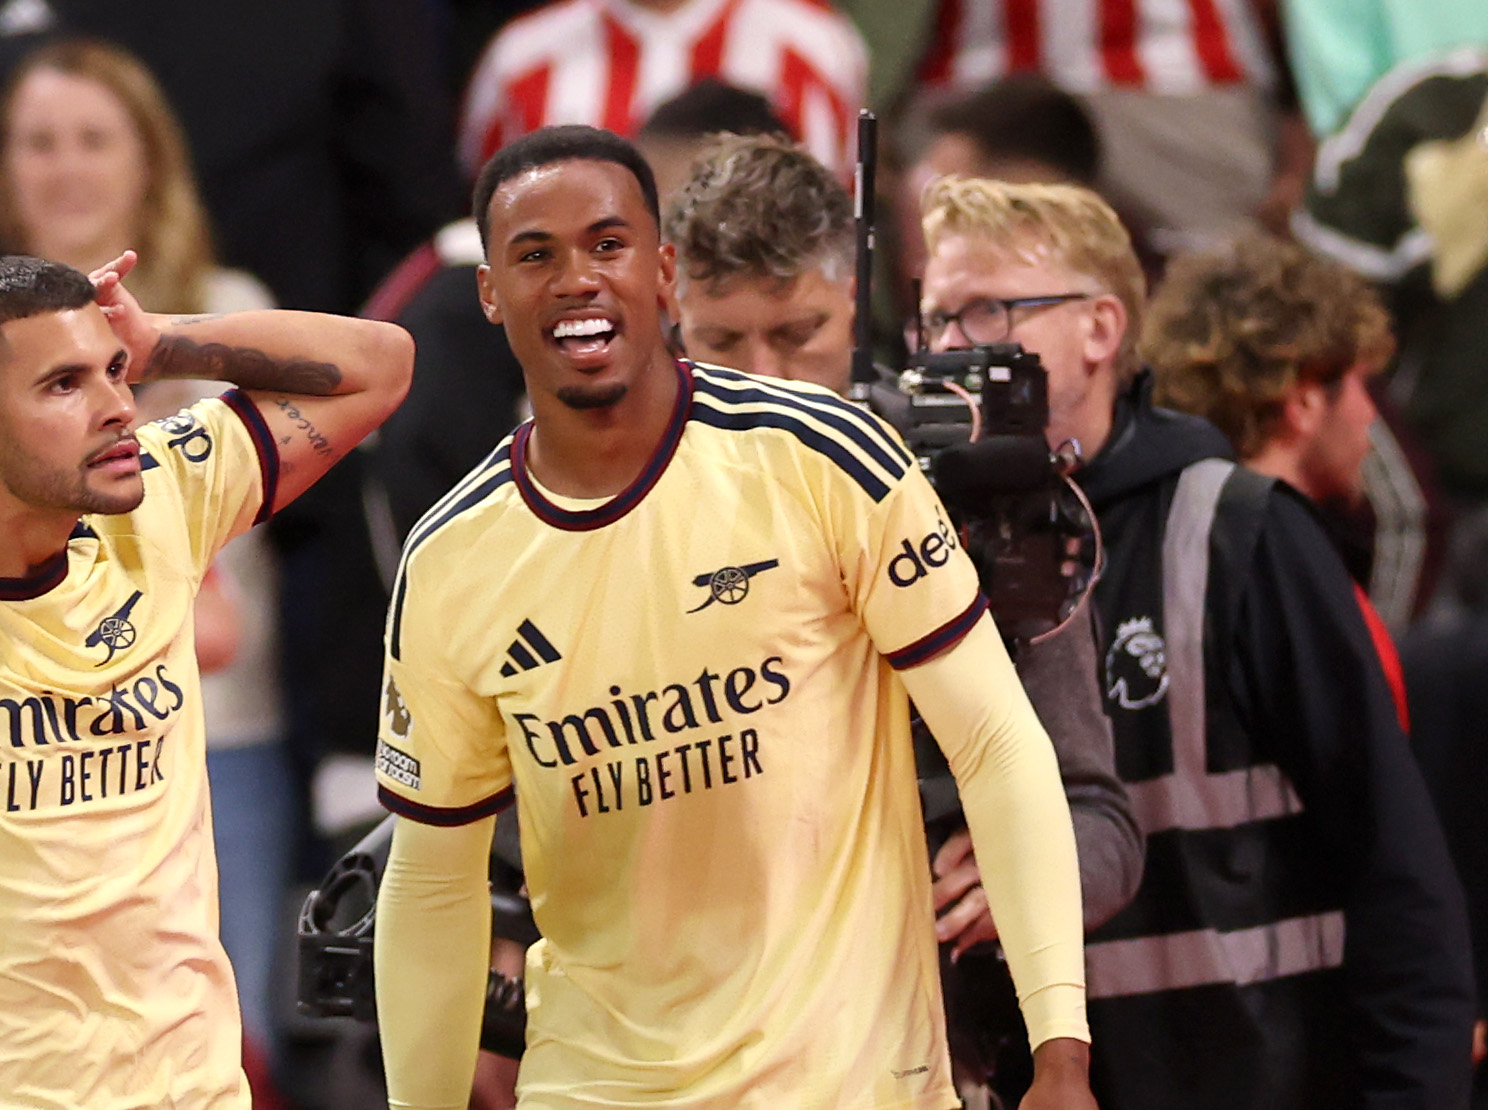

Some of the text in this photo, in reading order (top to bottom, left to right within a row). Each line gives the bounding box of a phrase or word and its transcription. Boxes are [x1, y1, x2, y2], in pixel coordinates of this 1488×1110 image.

[511, 655, 792, 768] Emirates
[60, 734, 167, 807] BETTER
[570, 727, 764, 818] FLY BETTER
